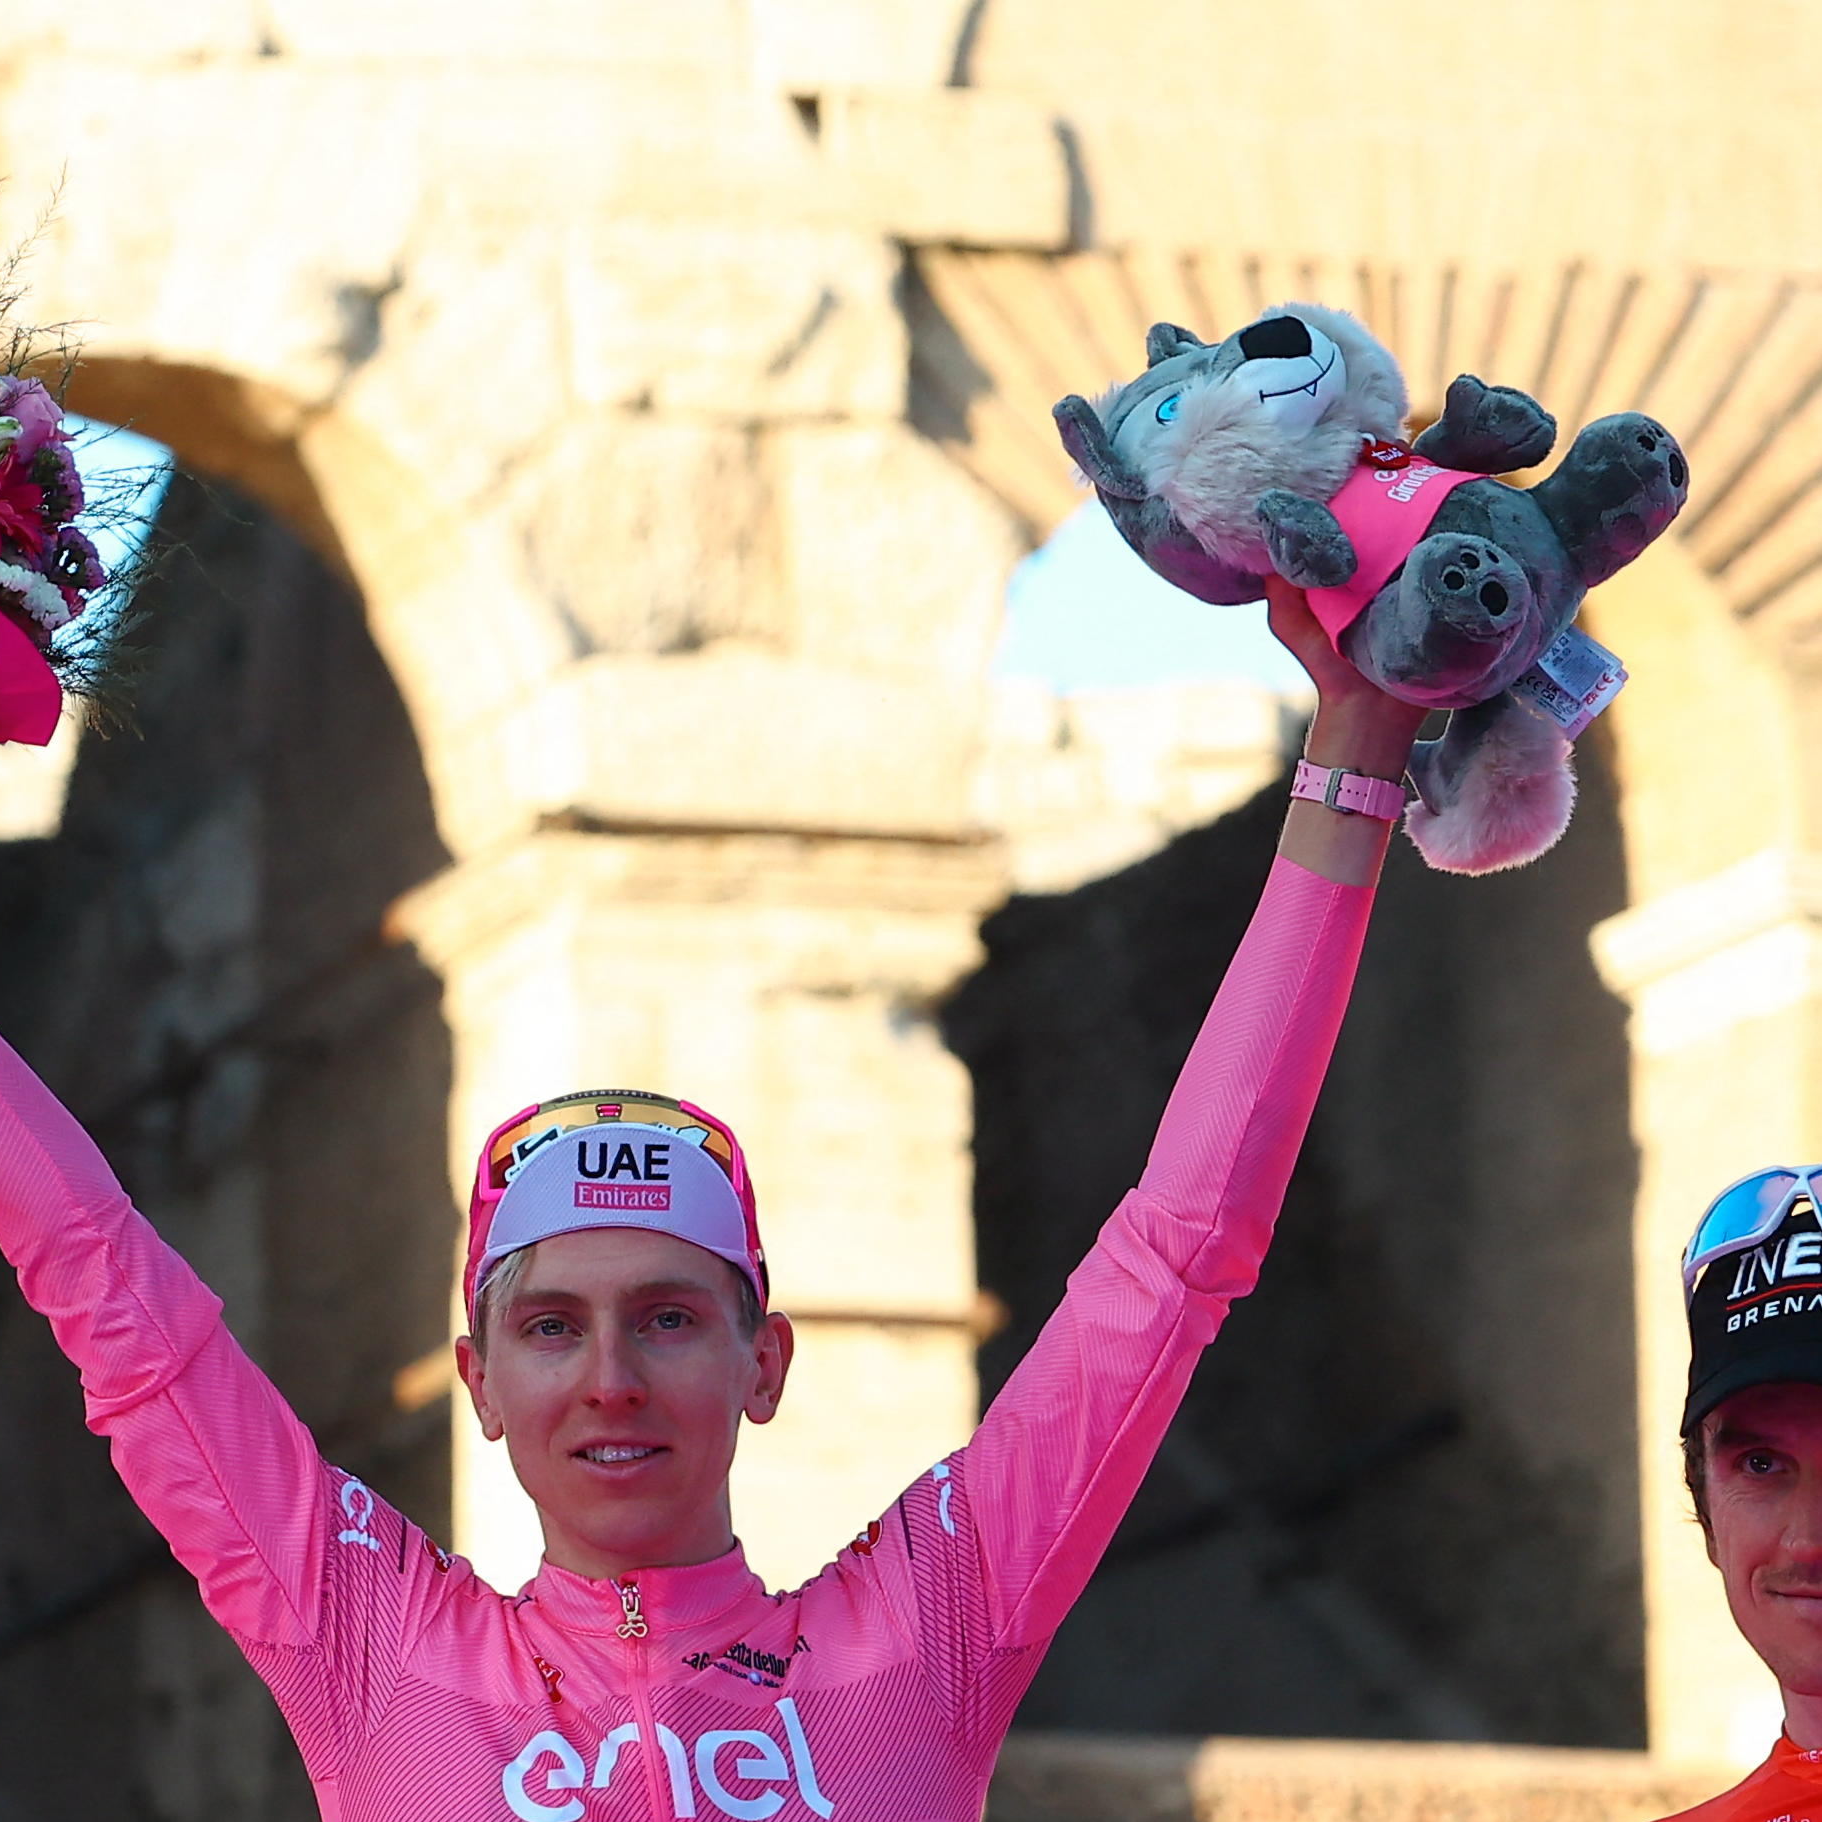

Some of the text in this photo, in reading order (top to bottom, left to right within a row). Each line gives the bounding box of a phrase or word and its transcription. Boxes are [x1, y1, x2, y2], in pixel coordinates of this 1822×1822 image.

[578, 1141, 670, 1181] UAE
[578, 1185, 669, 1208] Emirates
[752, 1648, 785, 1679] dello
